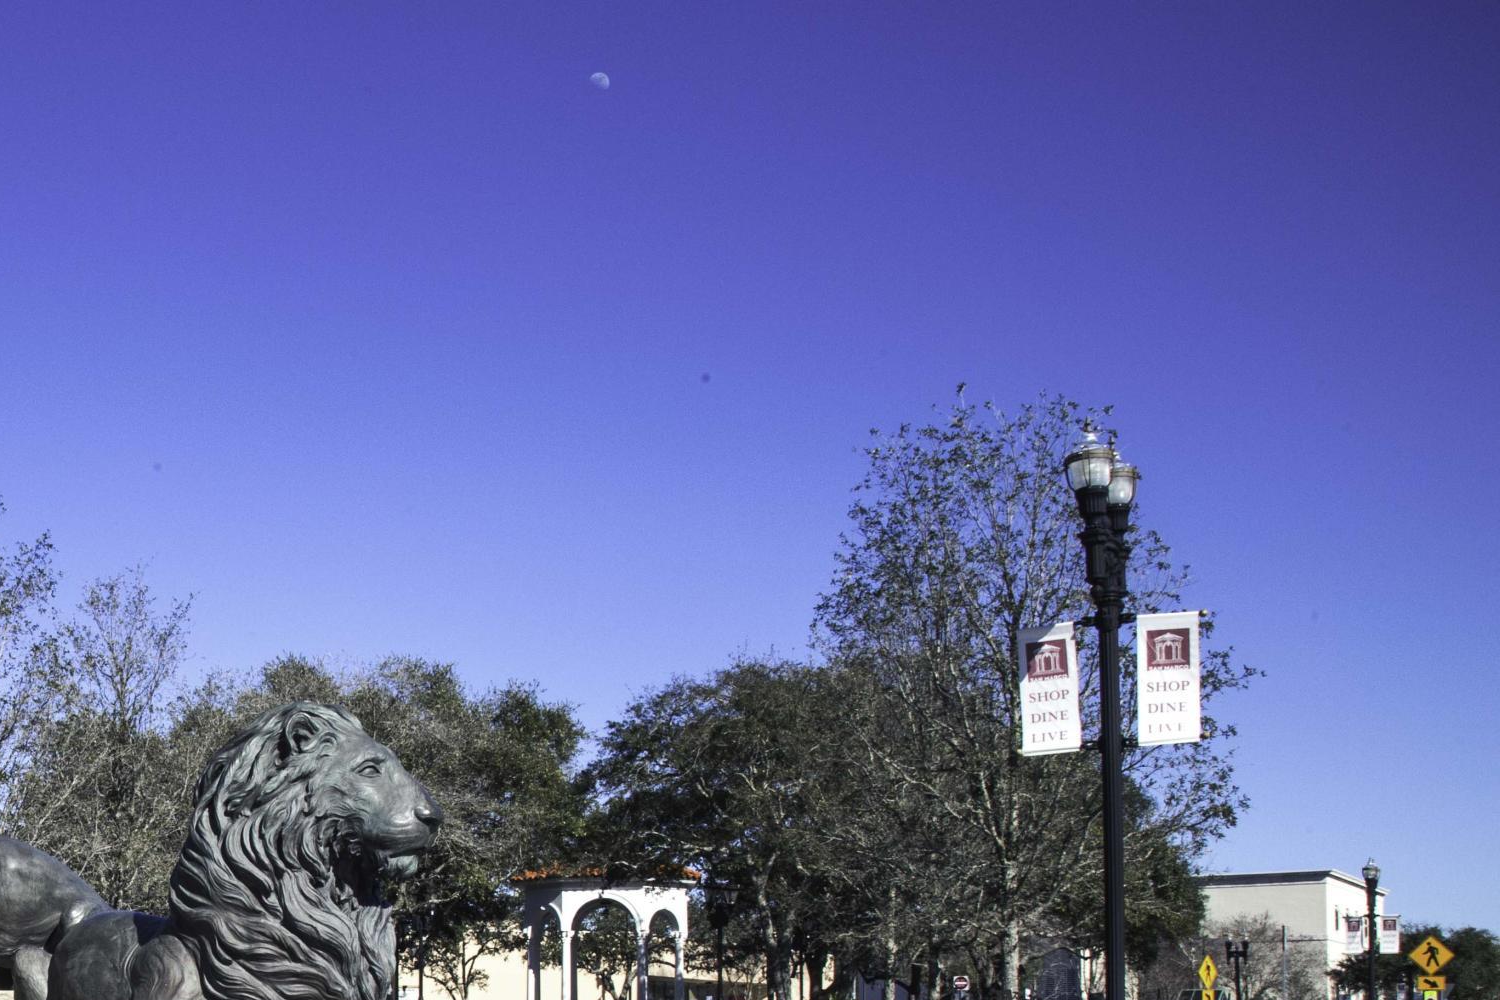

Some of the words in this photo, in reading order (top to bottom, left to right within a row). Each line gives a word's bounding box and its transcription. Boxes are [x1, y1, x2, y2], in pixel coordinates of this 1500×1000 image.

[1146, 680, 1190, 693] SHOP
[1029, 689, 1070, 703] SHOP
[1148, 701, 1188, 714] DINE
[1031, 710, 1069, 724] DINE
[1148, 722, 1187, 734] LIVE
[1032, 730, 1068, 743] LIVE
